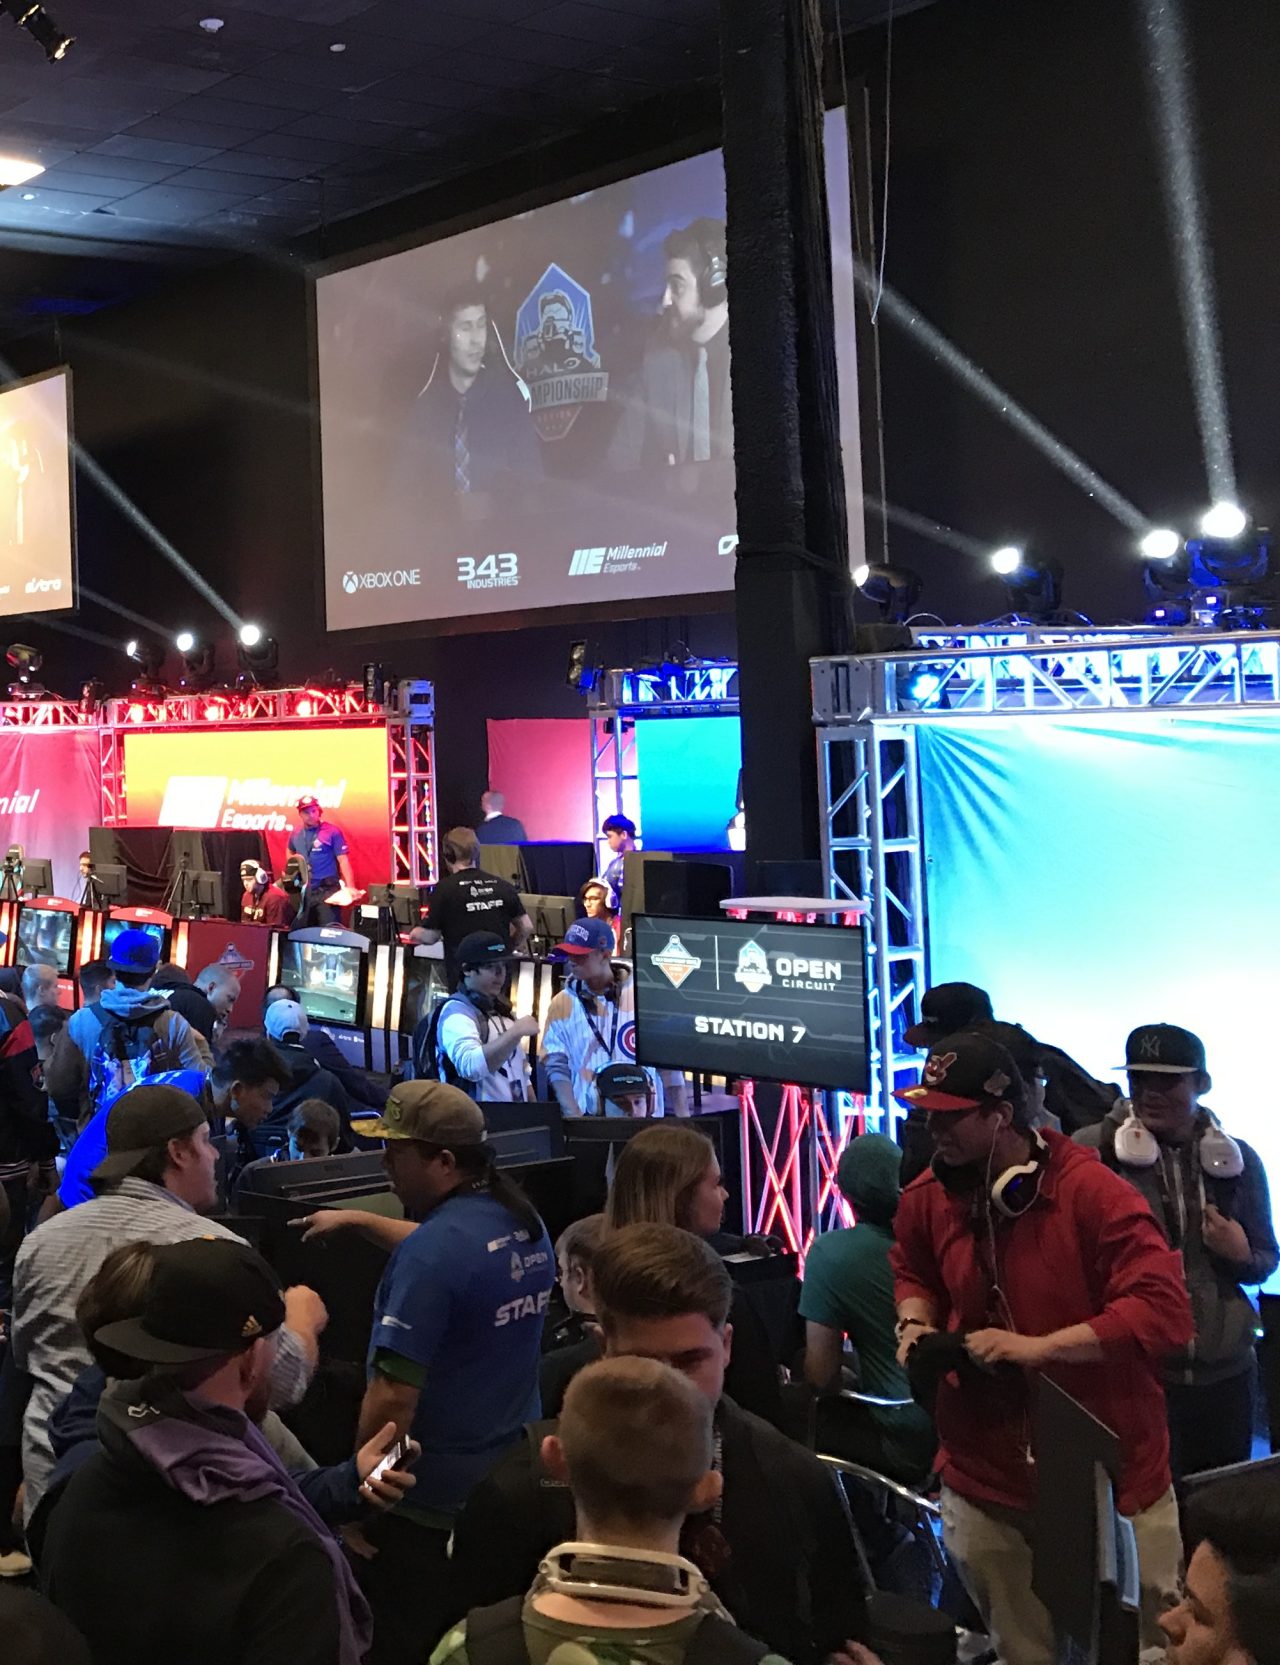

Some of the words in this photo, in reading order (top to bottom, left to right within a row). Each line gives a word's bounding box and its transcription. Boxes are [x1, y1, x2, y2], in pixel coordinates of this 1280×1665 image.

[526, 357, 581, 378] HALO
[606, 541, 668, 561] Millennial
[456, 552, 518, 582] 343
[467, 576, 518, 590] INDUSTRIES
[466, 899, 504, 912] STAFF
[775, 957, 842, 981] OPEN
[782, 978, 836, 992] CIRCUIT
[694, 1015, 785, 1043] STATION
[791, 1026, 807, 1044] 7
[494, 1289, 552, 1328] STAF
